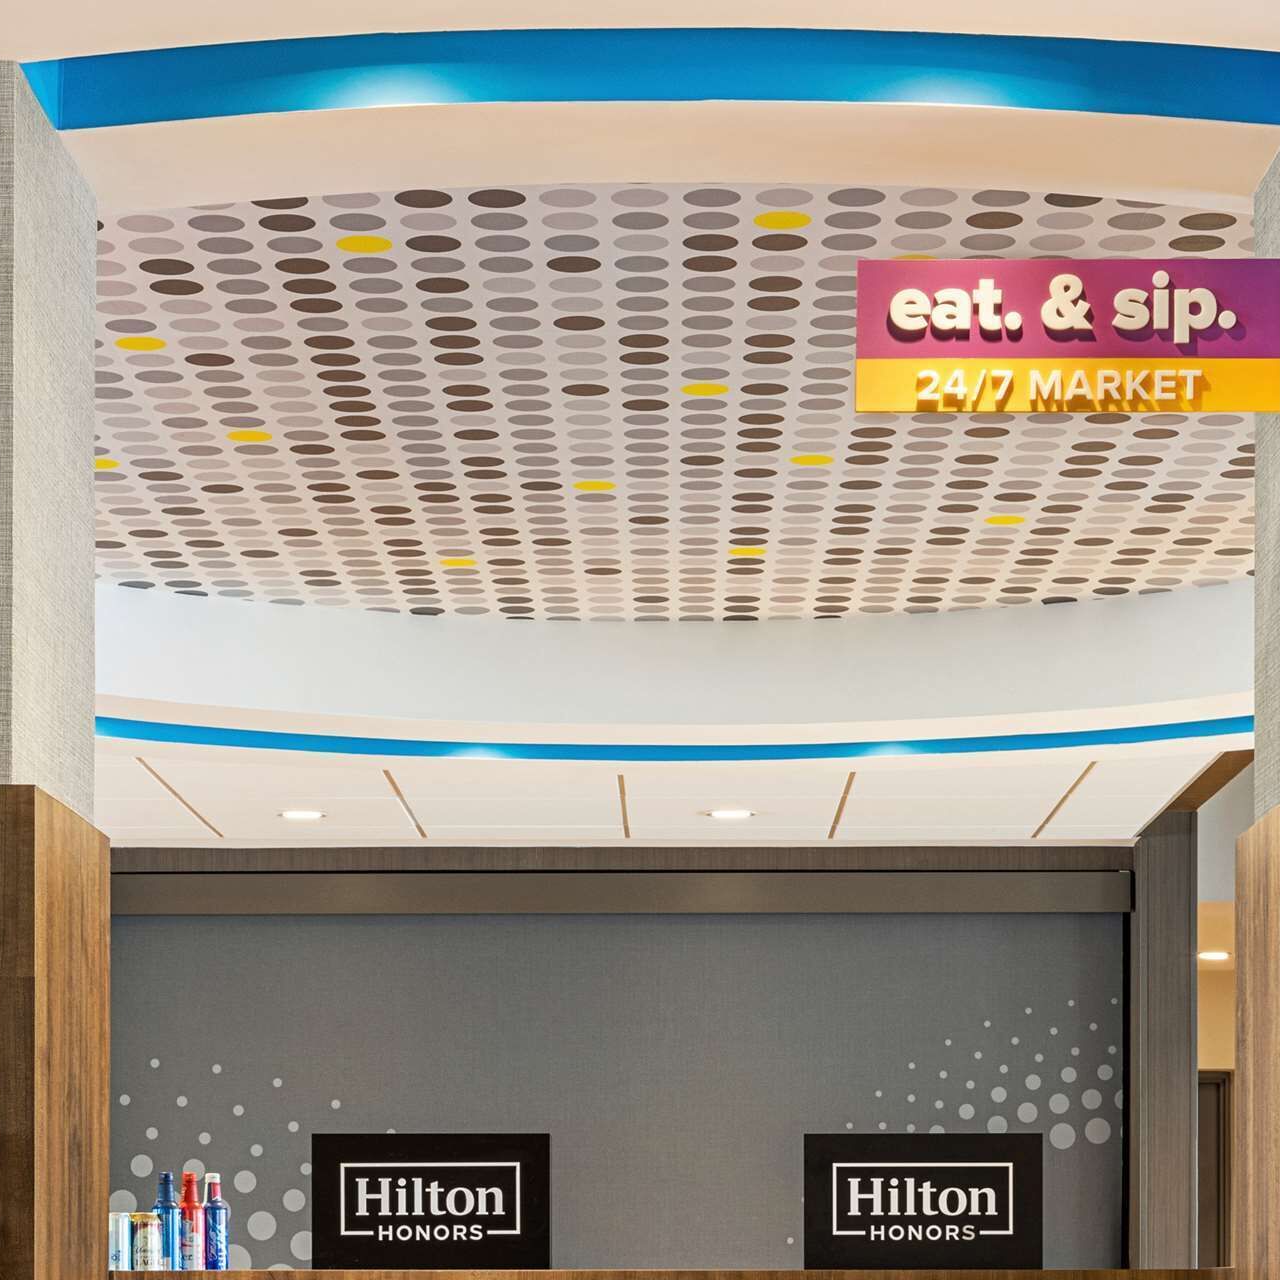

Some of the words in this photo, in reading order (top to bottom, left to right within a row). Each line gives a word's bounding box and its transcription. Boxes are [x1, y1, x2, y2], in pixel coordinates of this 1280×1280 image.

[889, 278, 1023, 331] eat.
[1040, 273, 1093, 331] &
[1111, 270, 1238, 344] sip.
[916, 369, 1015, 401] 24/7
[1029, 369, 1203, 401] MARKET
[355, 1177, 506, 1217] Hilton
[847, 1178, 999, 1217] Hilton
[377, 1224, 484, 1241] HONORS
[869, 1224, 976, 1241] HONORS
